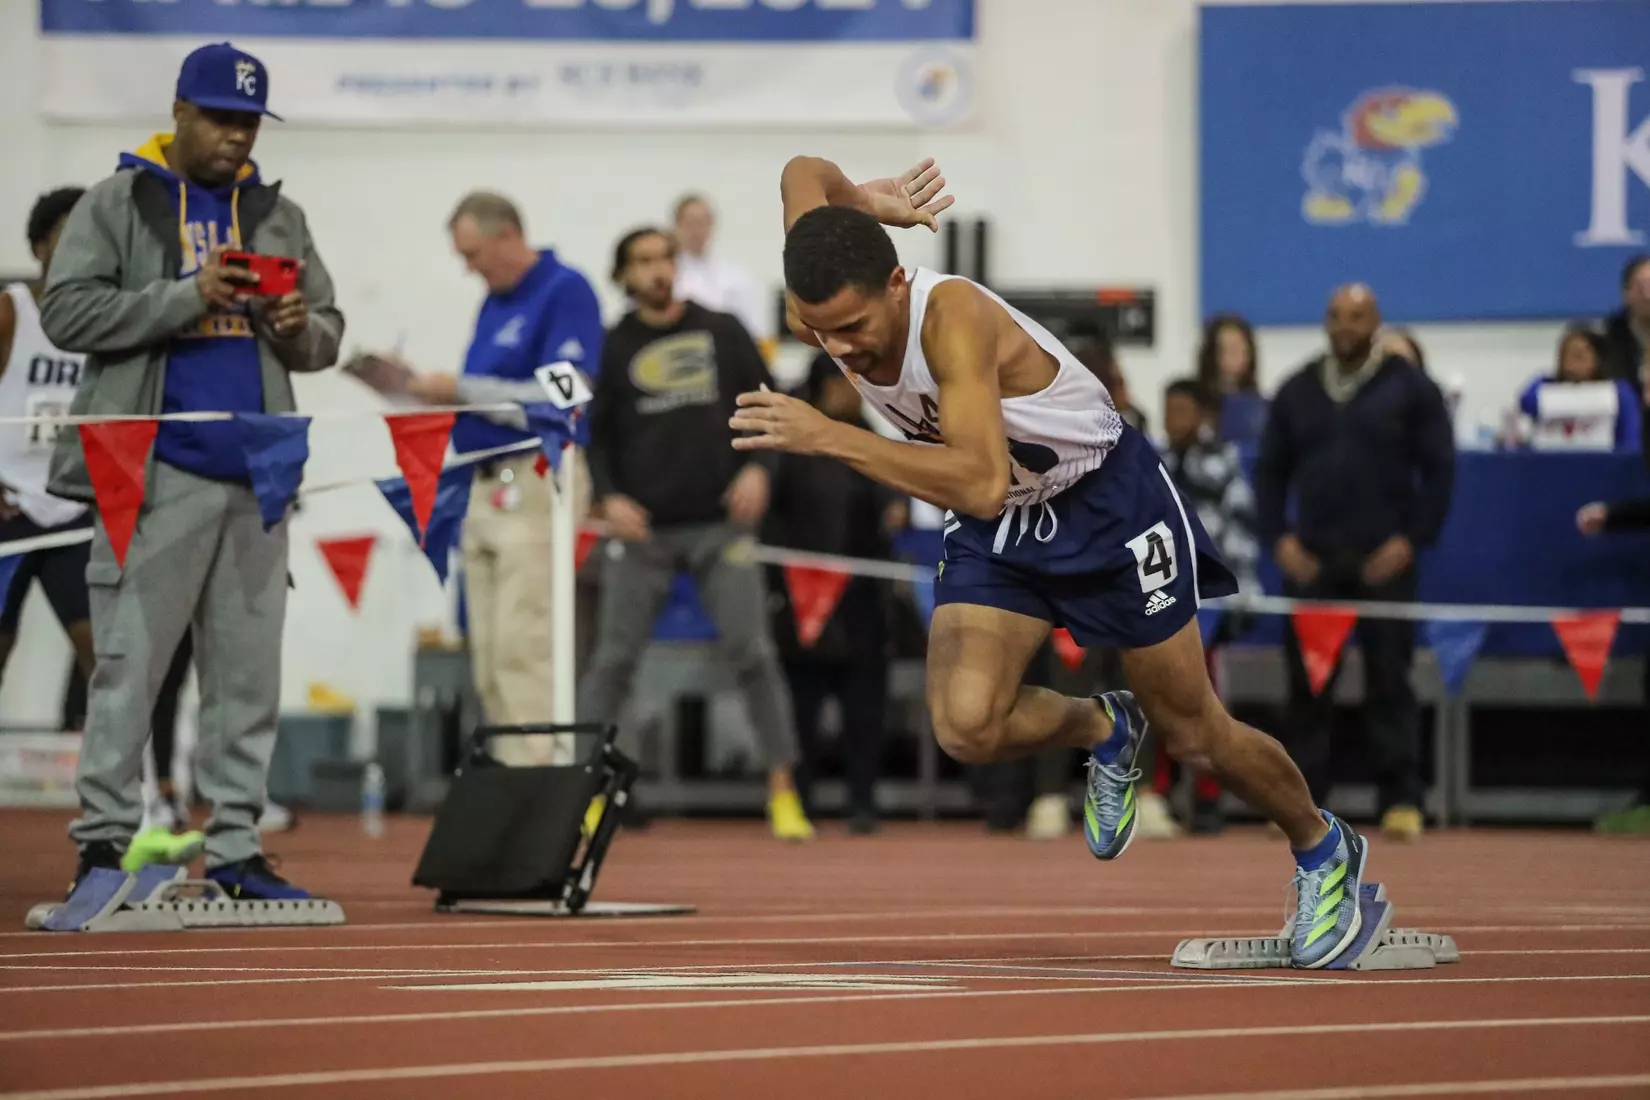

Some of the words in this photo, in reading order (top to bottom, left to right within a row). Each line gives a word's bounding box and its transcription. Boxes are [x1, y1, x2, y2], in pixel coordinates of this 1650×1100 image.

[1571, 67, 1650, 247] K
[1143, 531, 1172, 580] 4
[1145, 596, 1176, 616] adidas
